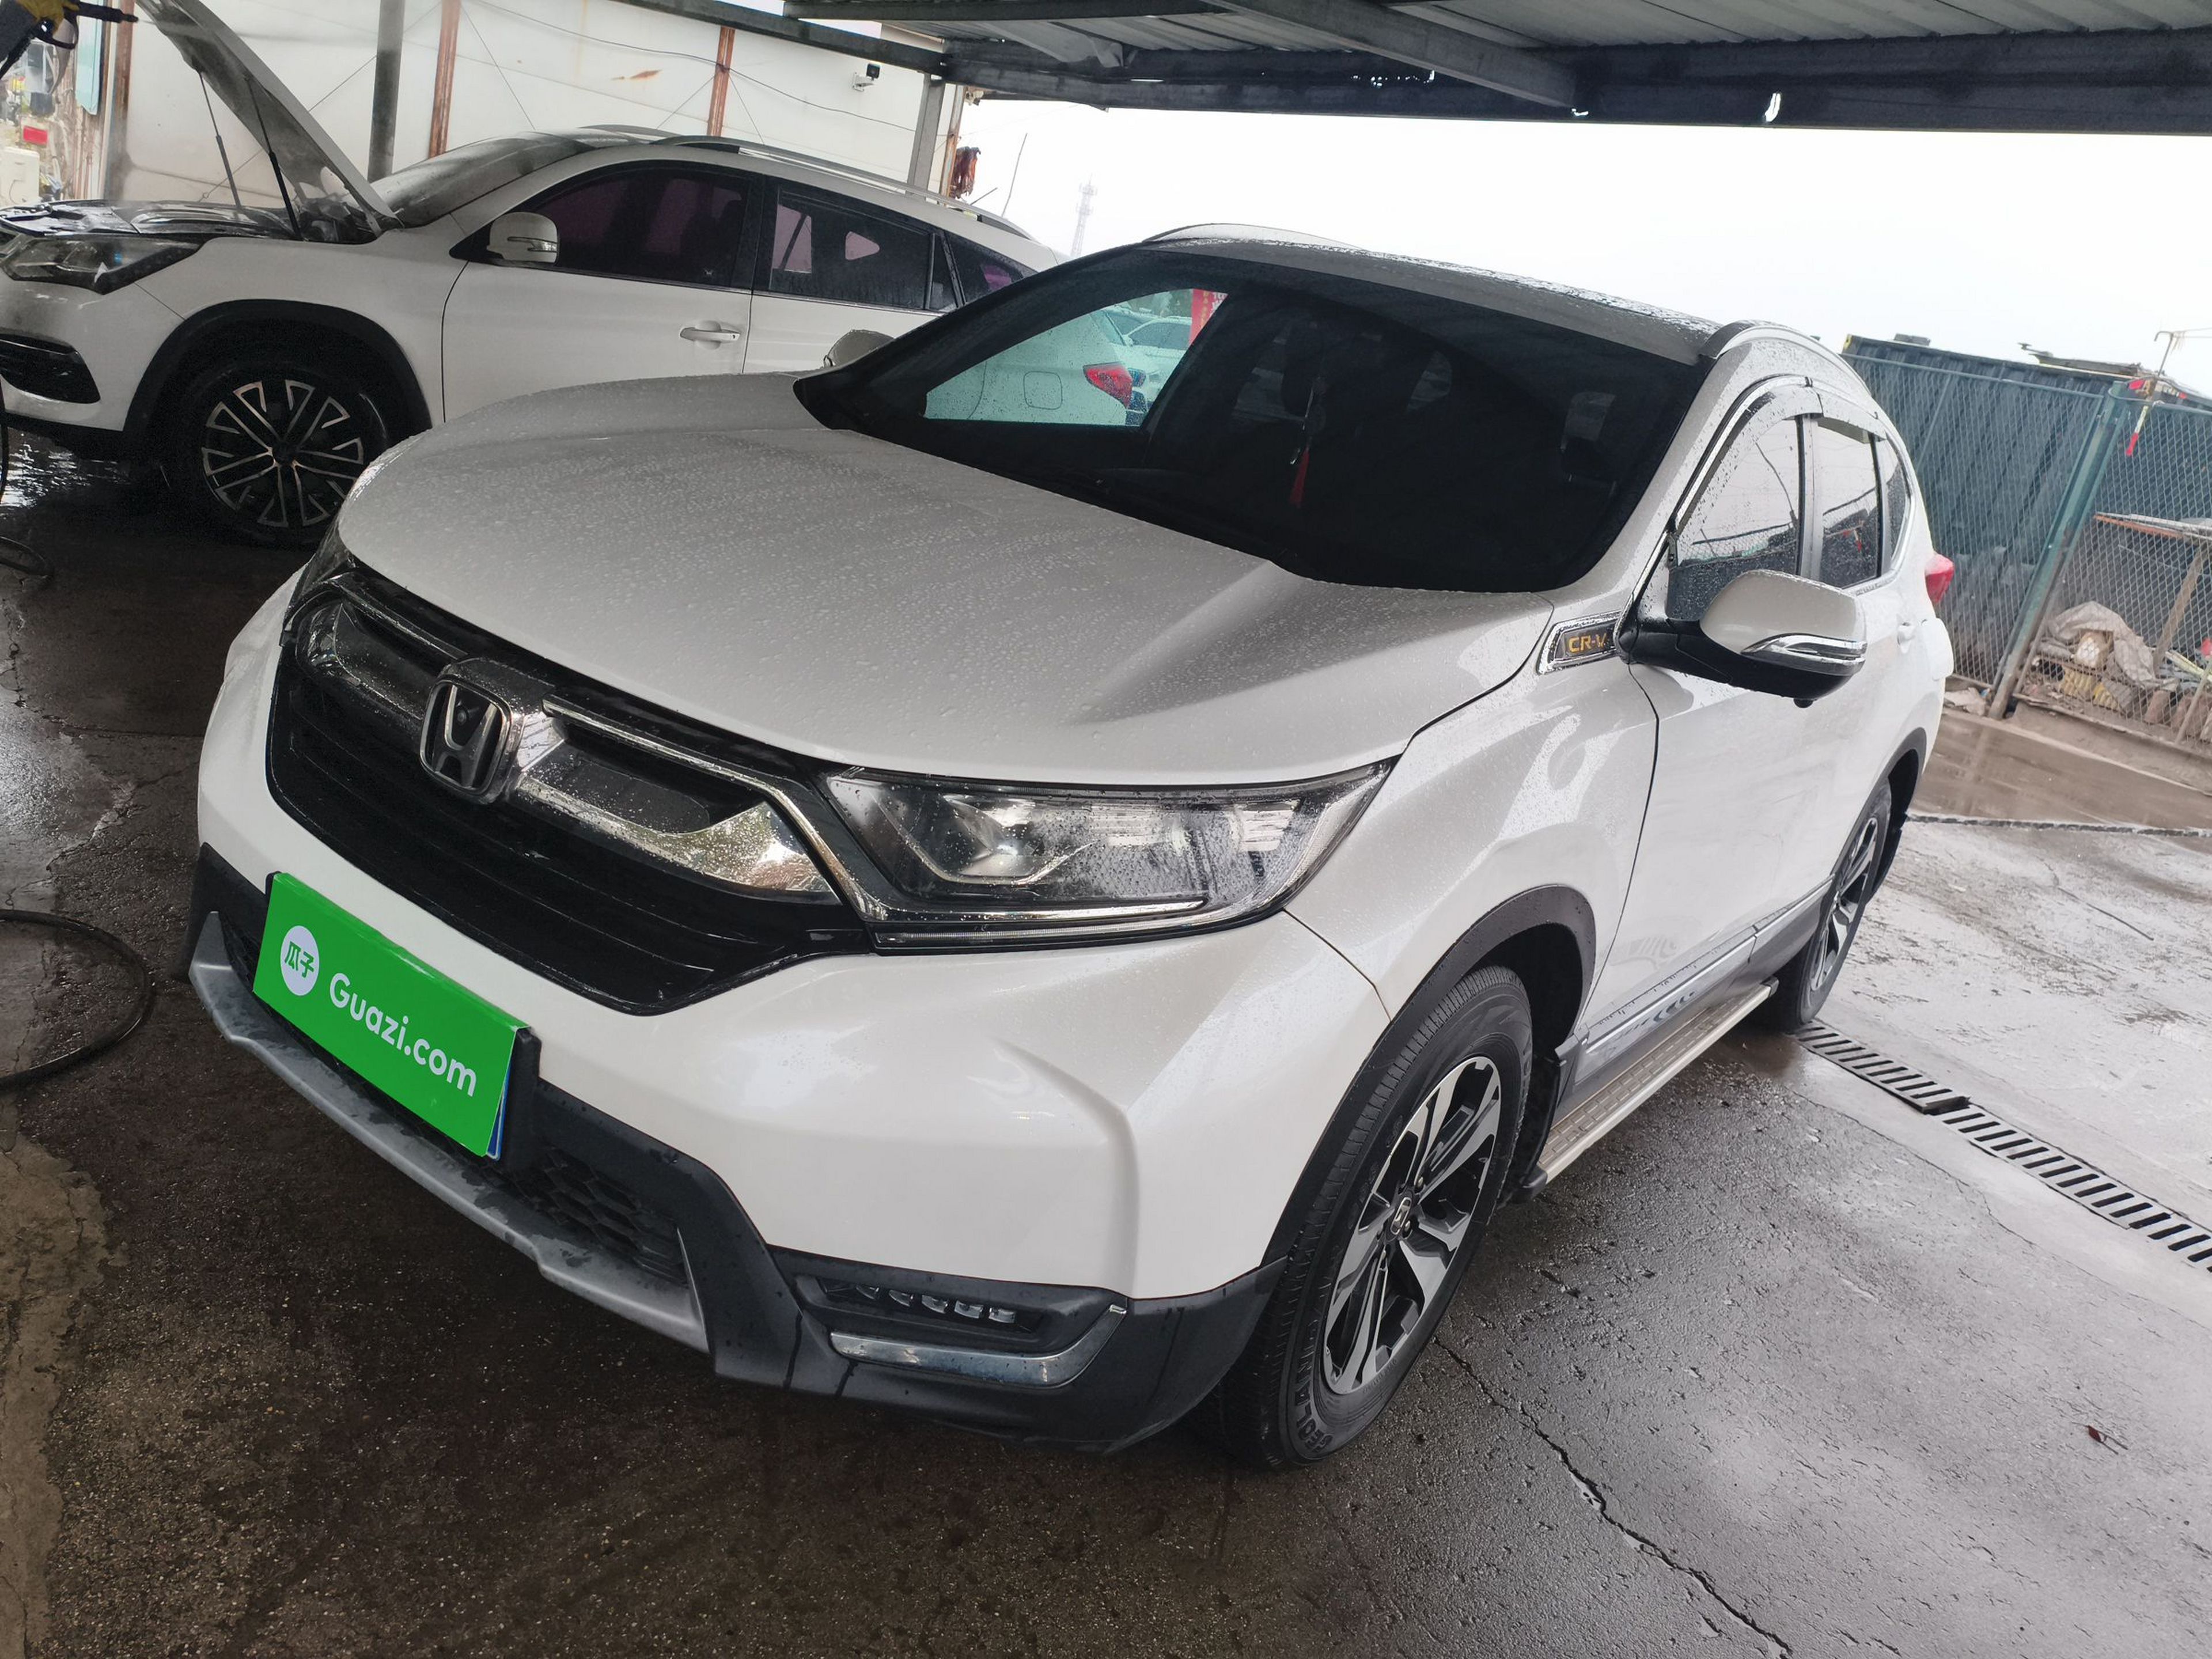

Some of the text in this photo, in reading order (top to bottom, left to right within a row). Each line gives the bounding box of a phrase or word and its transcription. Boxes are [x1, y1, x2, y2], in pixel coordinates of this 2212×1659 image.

[1569, 633, 1607, 653] CR-V
[284, 941, 315, 978] 瓜子
[329, 972, 478, 1097] Guazi.com
